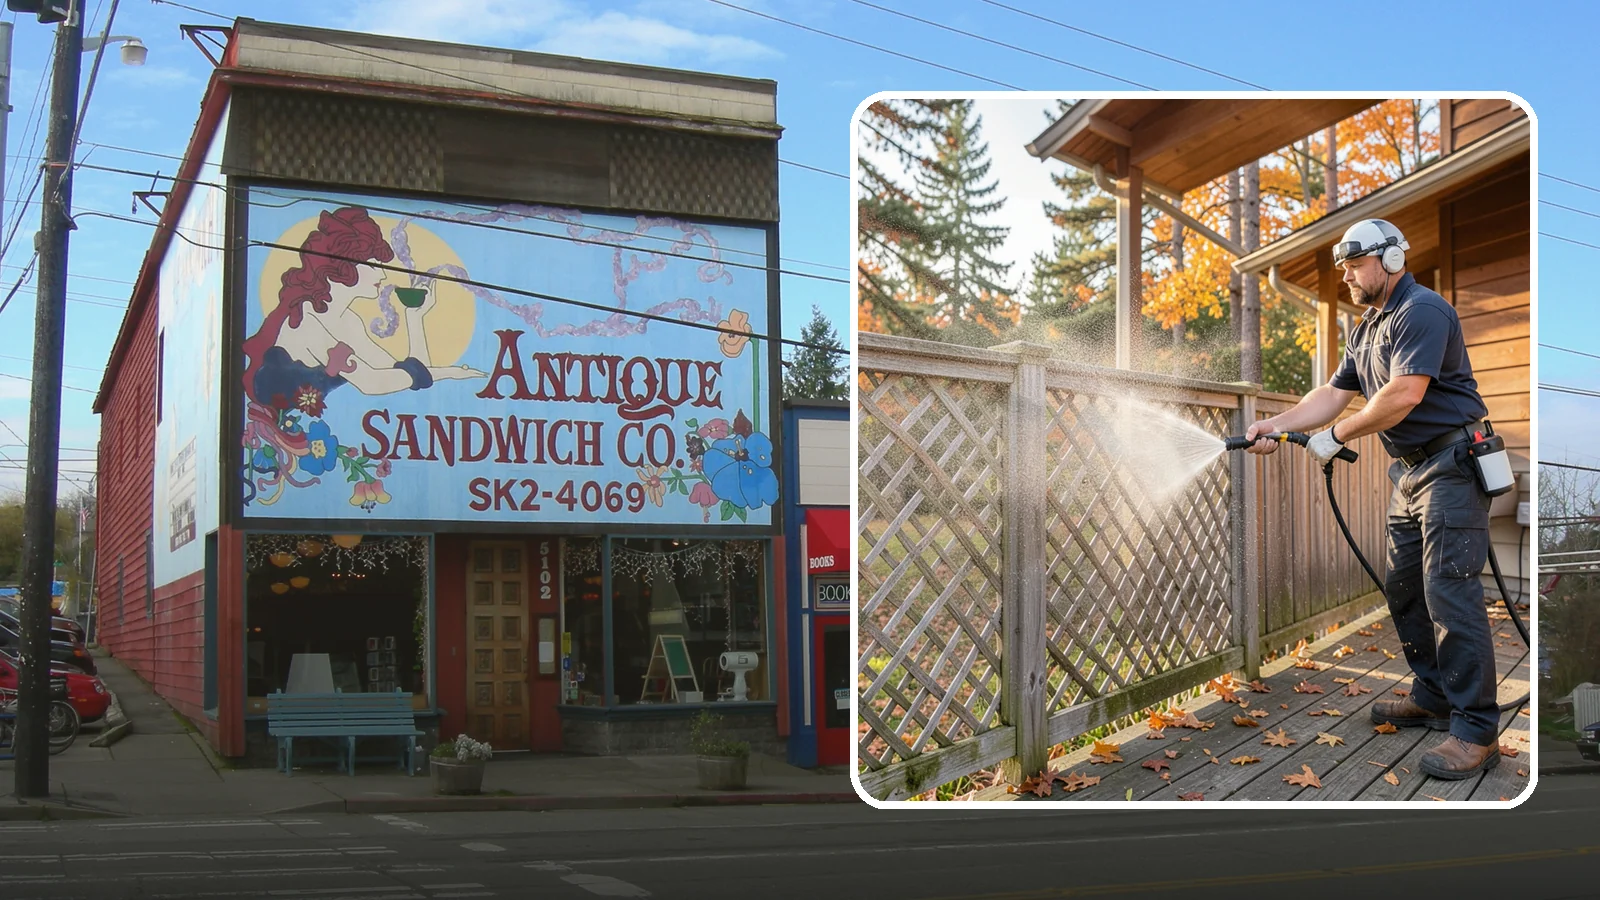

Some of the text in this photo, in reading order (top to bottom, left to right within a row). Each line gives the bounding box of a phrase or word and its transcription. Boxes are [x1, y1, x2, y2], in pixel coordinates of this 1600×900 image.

[475, 329, 724, 421] ANTIQUE
[361, 408, 685, 469] SANDWICH CO.
[468, 477, 646, 513] SK2-4069
[539, 541, 552, 600] 5102
[809, 555, 835, 569] BOOKS
